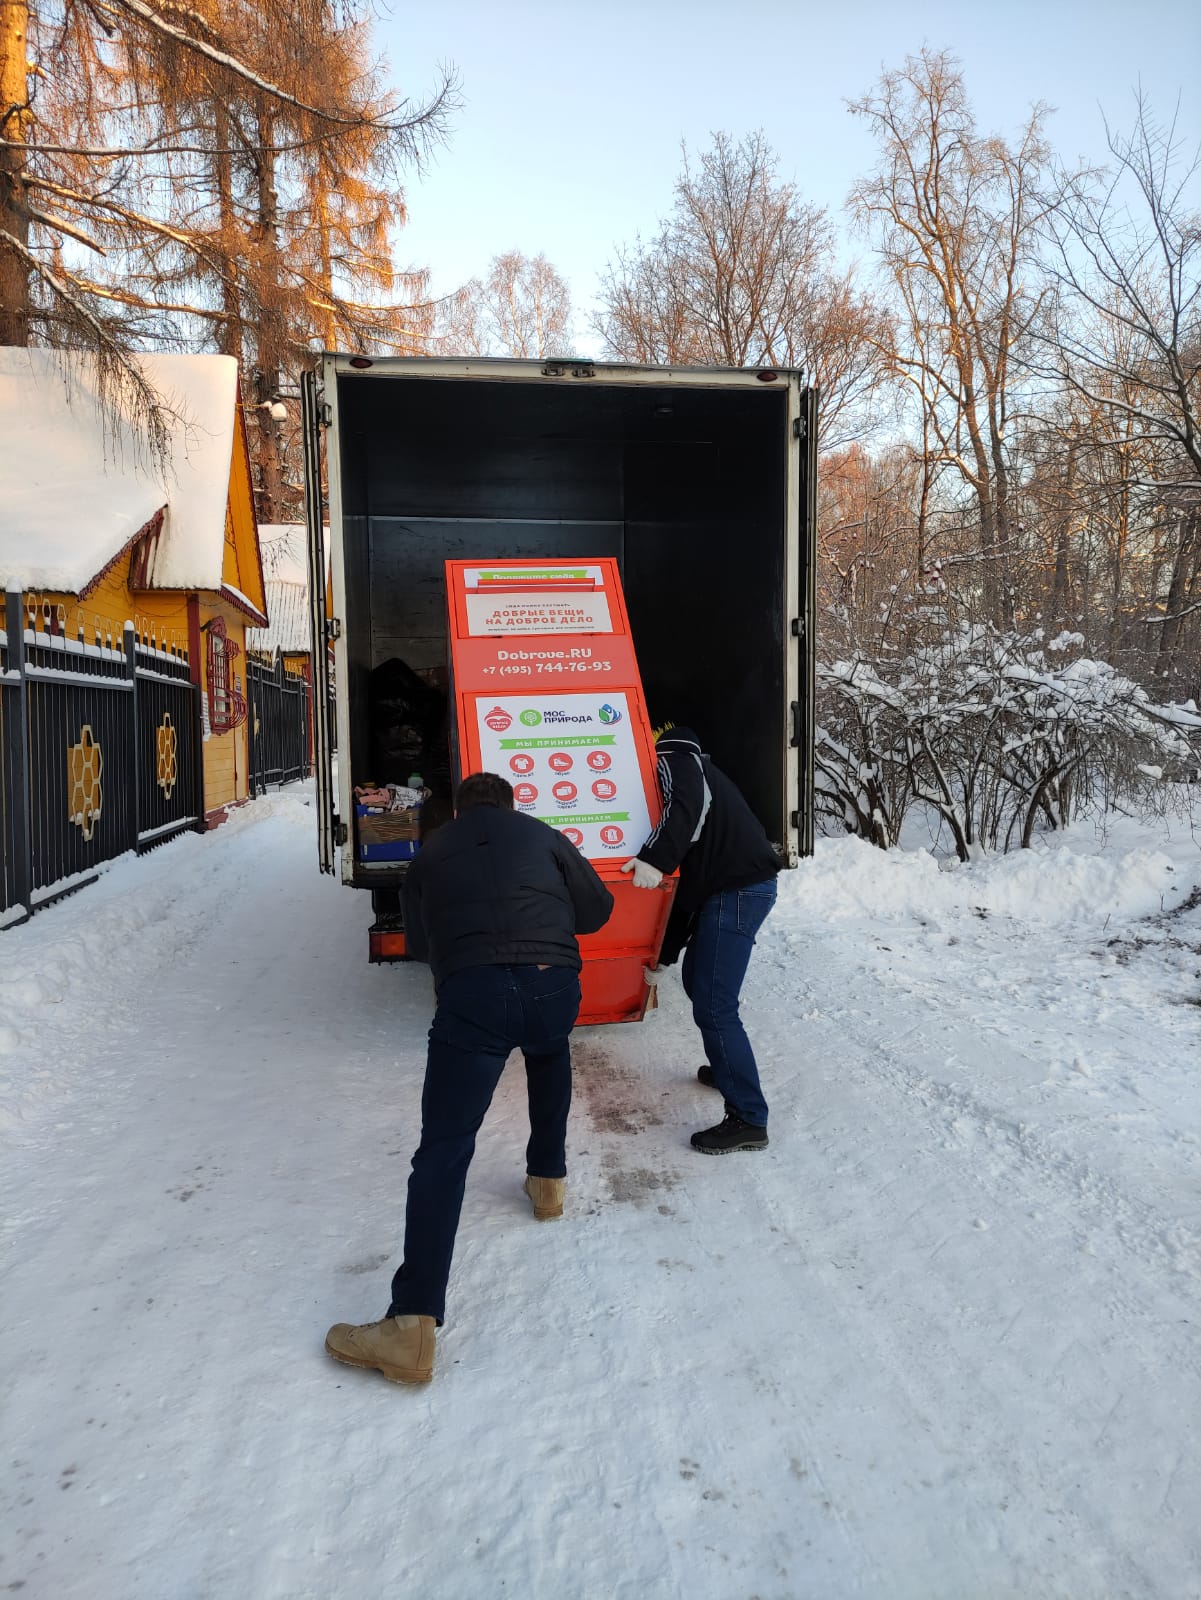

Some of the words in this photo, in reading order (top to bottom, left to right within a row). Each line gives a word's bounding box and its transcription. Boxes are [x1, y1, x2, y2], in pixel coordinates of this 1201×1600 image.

[493, 609, 545, 618] ДОБРЫЕ
[548, 609, 585, 617] ВЕЩИ
[506, 617, 557, 626] ДОБРОЕ
[560, 616, 593, 625] ДЕЛО
[497, 648, 592, 661] Dobrove.RU
[482, 667, 496, 675] +7
[499, 665, 532, 676] (495)
[535, 661, 612, 673] 744-76-93
[544, 716, 593, 724] ПРИРОДА
[537, 738, 600, 747] ПРИНИМАЕМ
[558, 815, 612, 823] ПРИНИМАЕМ
